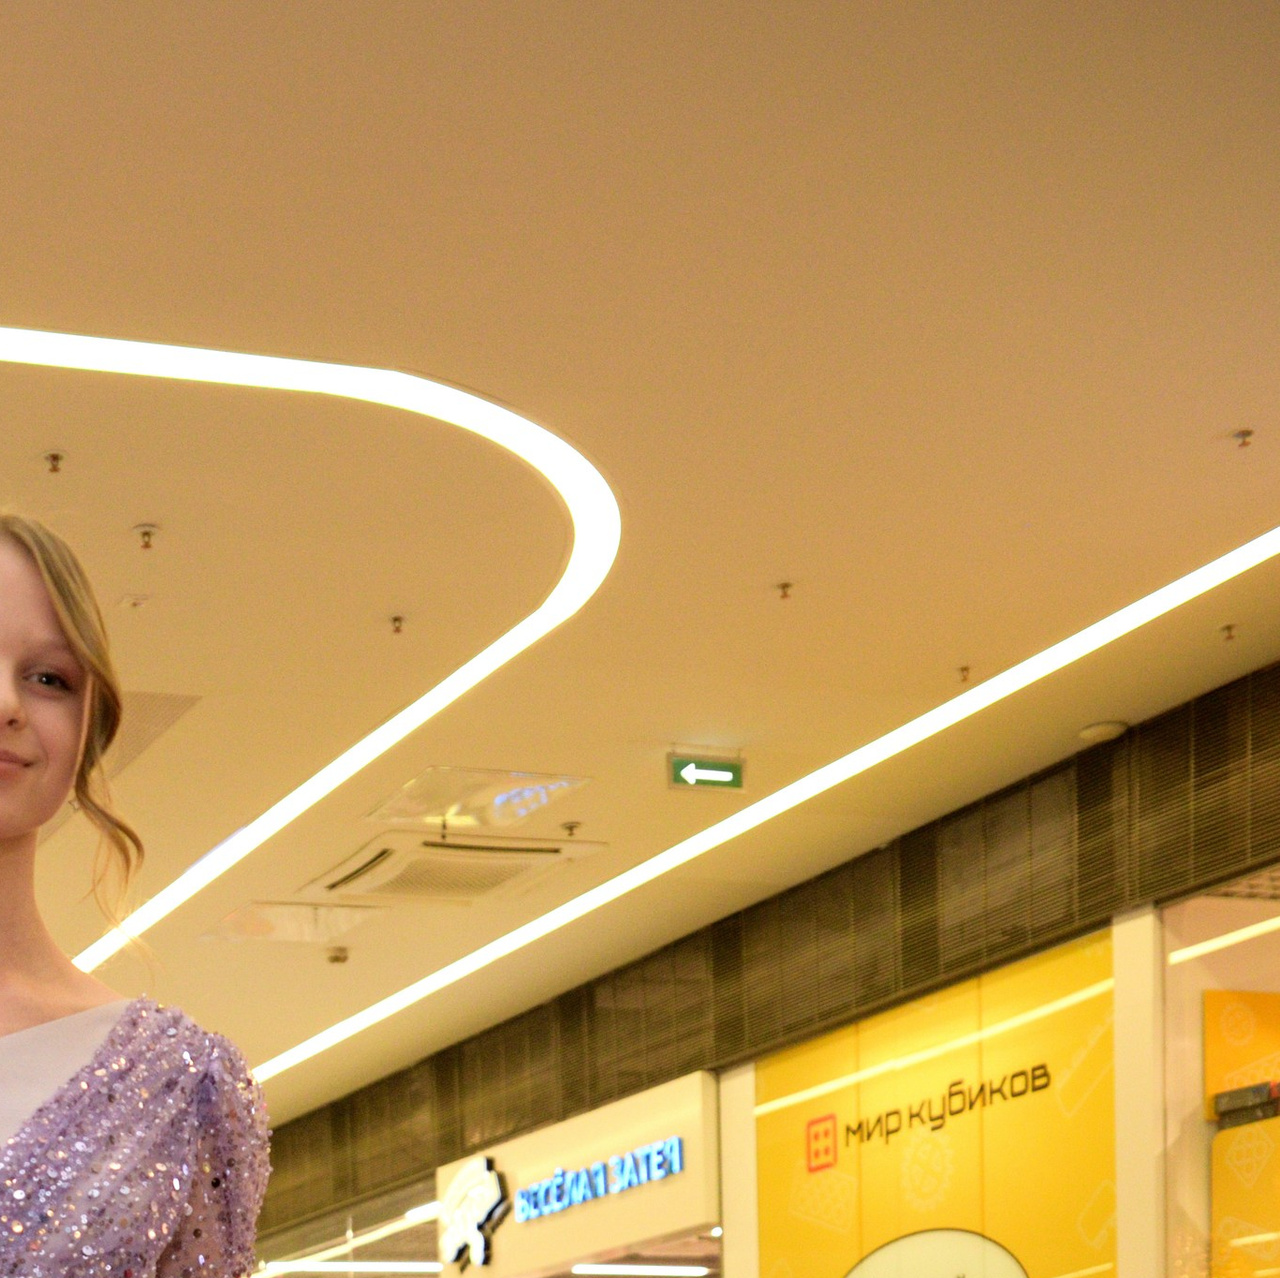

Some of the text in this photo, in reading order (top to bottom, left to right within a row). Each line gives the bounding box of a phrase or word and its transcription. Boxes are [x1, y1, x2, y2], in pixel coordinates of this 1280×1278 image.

[845, 1063, 1051, 1146] мир кубиков
[608, 1135, 684, 1194] ЗАТЕЯ
